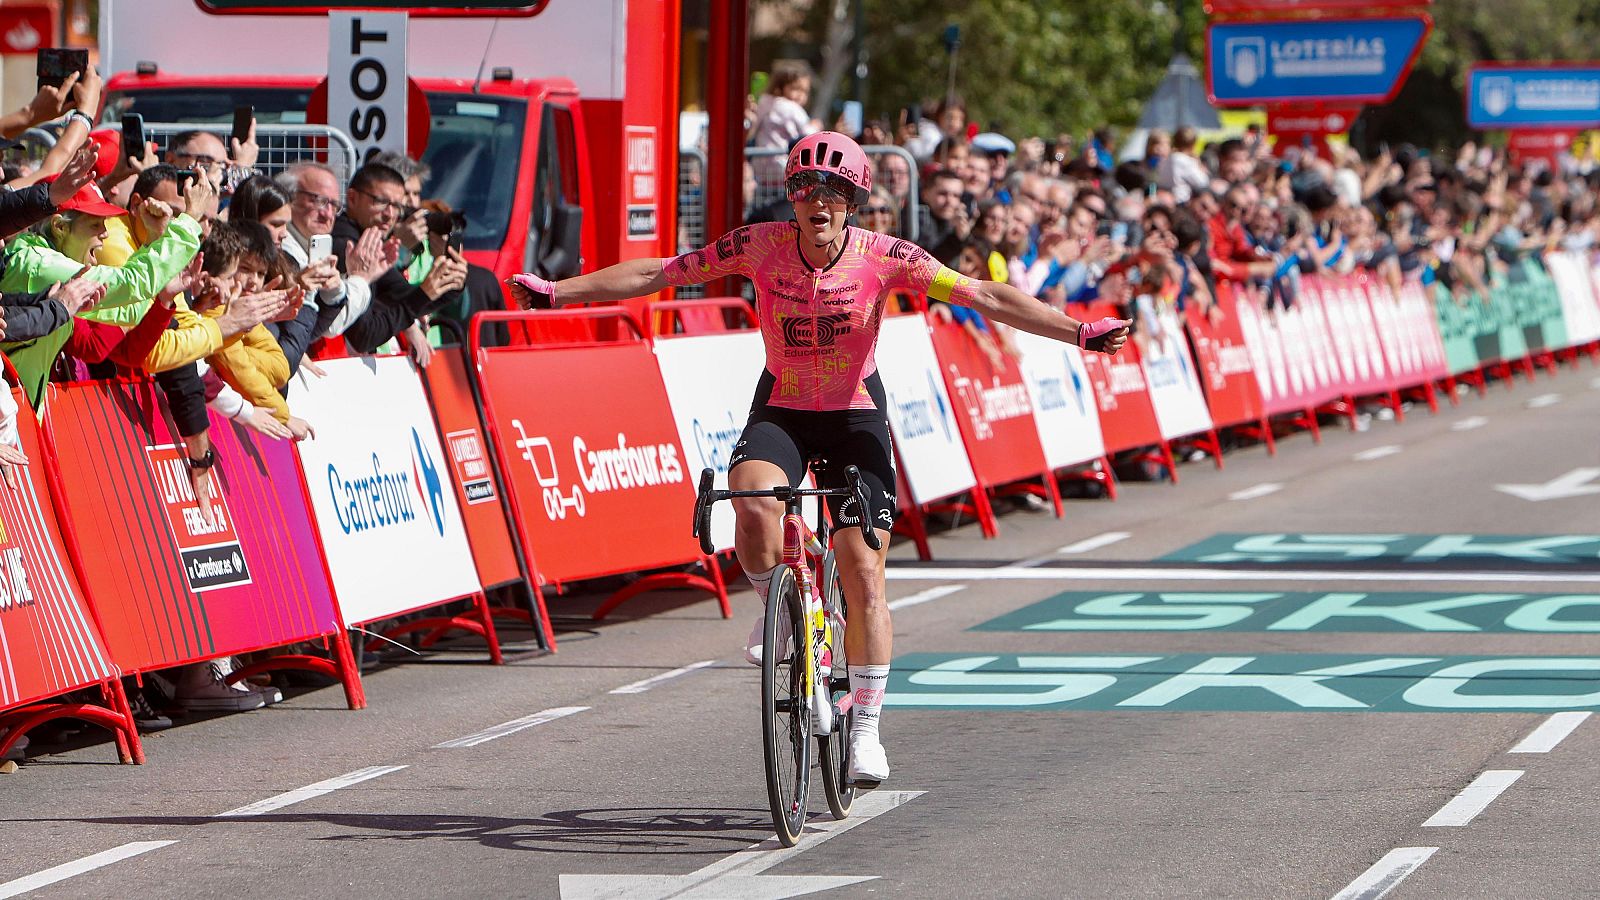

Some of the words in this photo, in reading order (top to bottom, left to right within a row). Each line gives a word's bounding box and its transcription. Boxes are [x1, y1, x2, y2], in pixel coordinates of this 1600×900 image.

[818, 283, 859, 296] easypost
[822, 298, 855, 306] wahoo
[784, 347, 835, 358] Educaion
[573, 432, 683, 493] Carrefour.es
[328, 451, 415, 535] Carrefour
[193, 557, 233, 579] Carrefour.es
